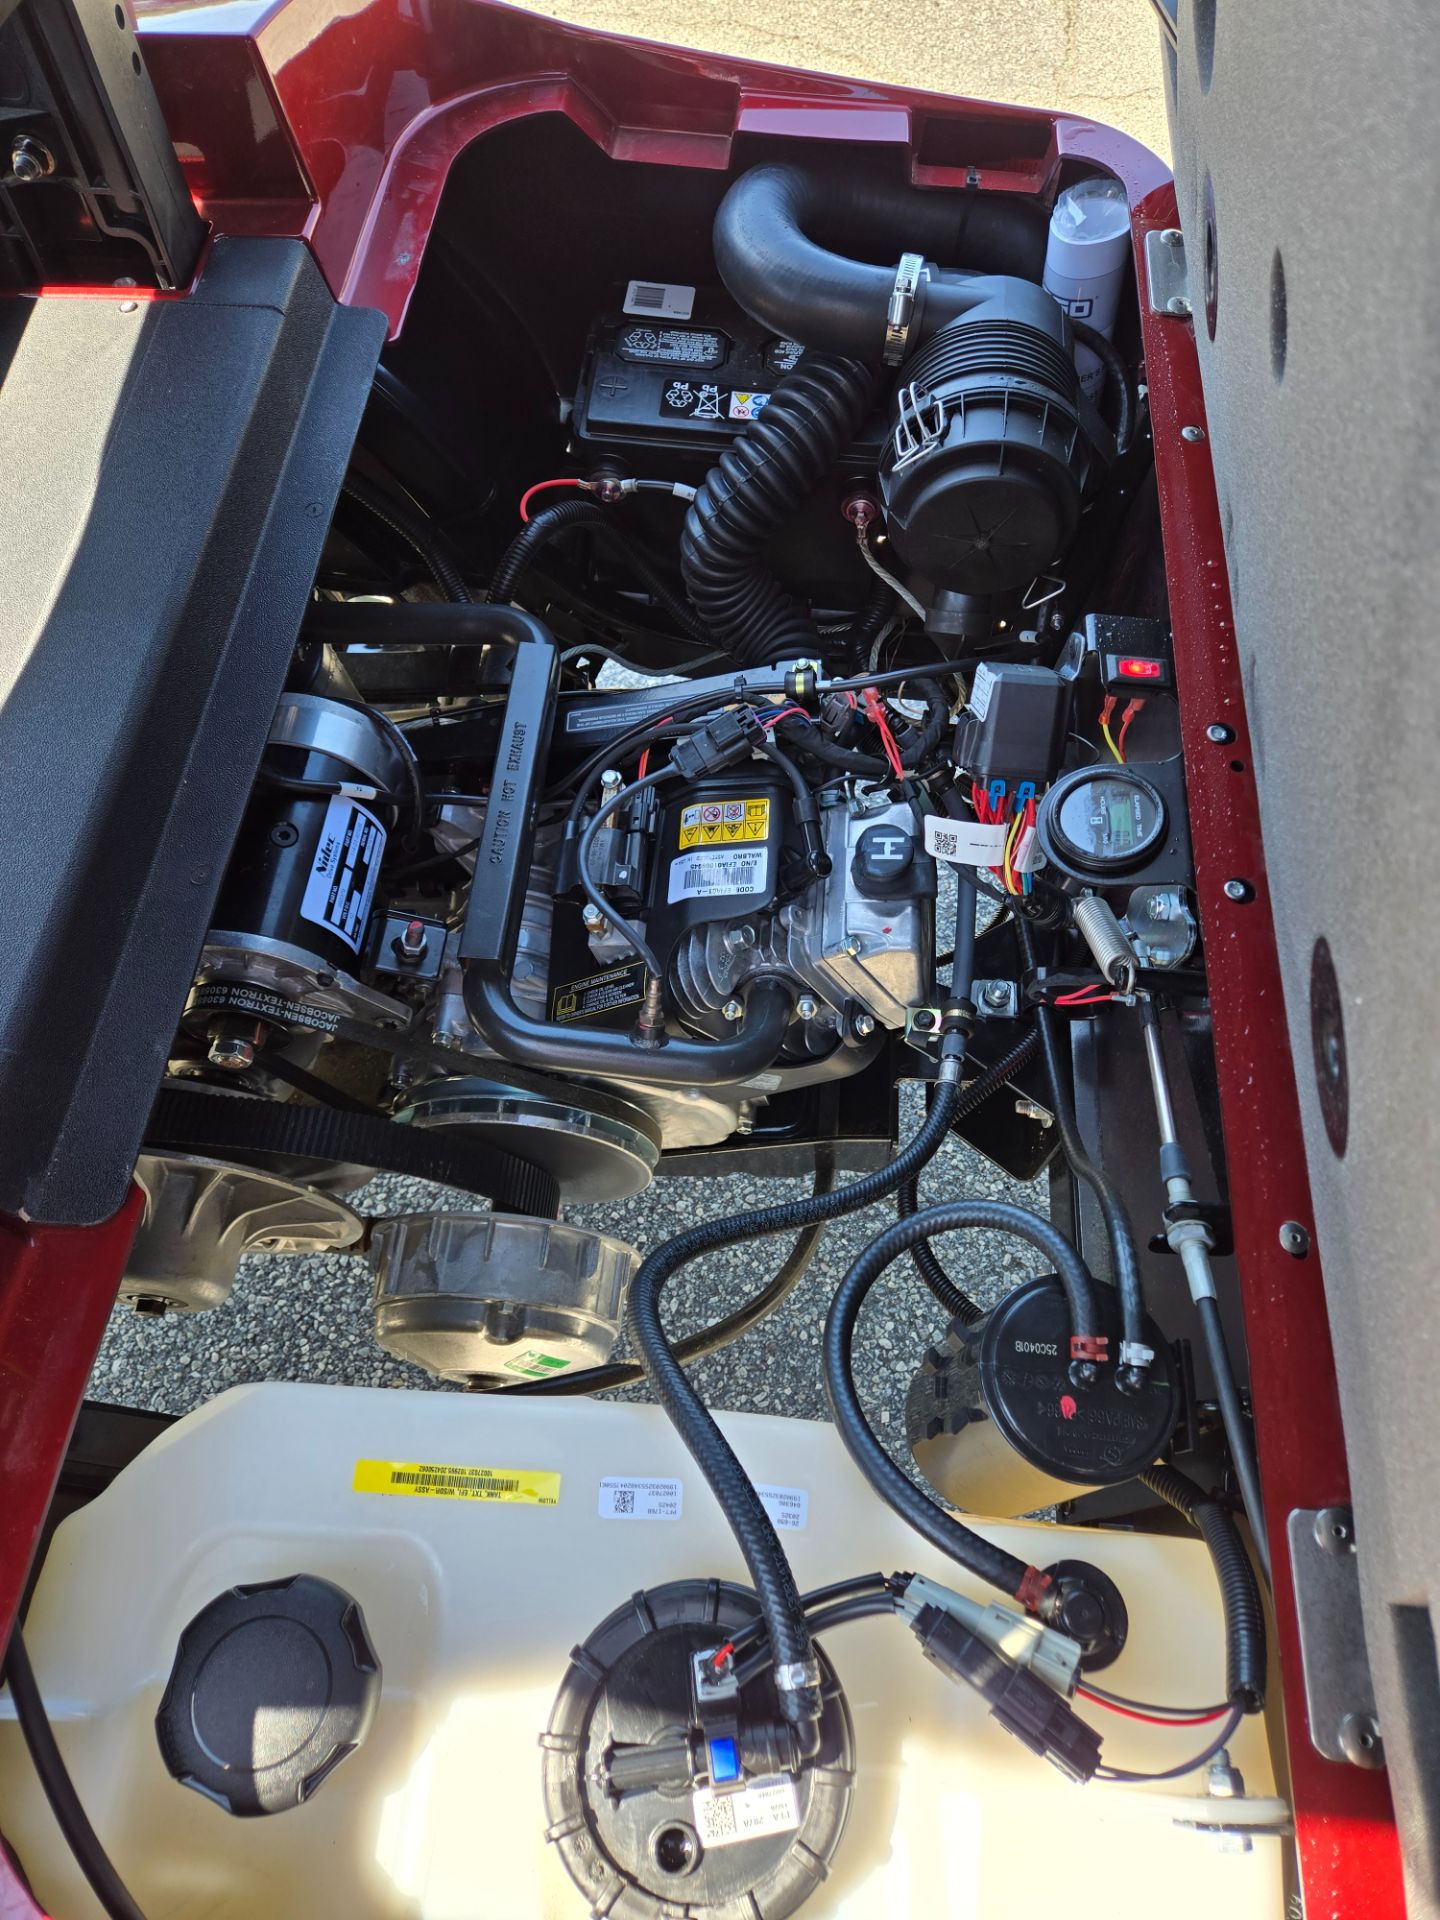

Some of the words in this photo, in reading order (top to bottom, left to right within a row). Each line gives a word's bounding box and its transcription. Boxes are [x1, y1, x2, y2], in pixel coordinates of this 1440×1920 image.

[672, 382, 689, 391] Pb
[701, 384, 718, 393] Pb
[507, 721, 527, 772] EXHAUST
[501, 779, 516, 802] HOT
[1134, 795, 1142, 821] ELAPSED
[489, 810, 511, 865] CAUTION
[315, 832, 336, 876] Nidec
[733, 852, 763, 860] WALBRO
[571, 981, 589, 991] ENGINE
[591, 969, 628, 984] MAINTENANCE
[228, 997, 338, 1033] JACOBSEN-TEXTRON
[231, 987, 341, 1024] JACOBSEN-TEXTRON
[1015, 1340, 1058, 1356] 25C0401B
